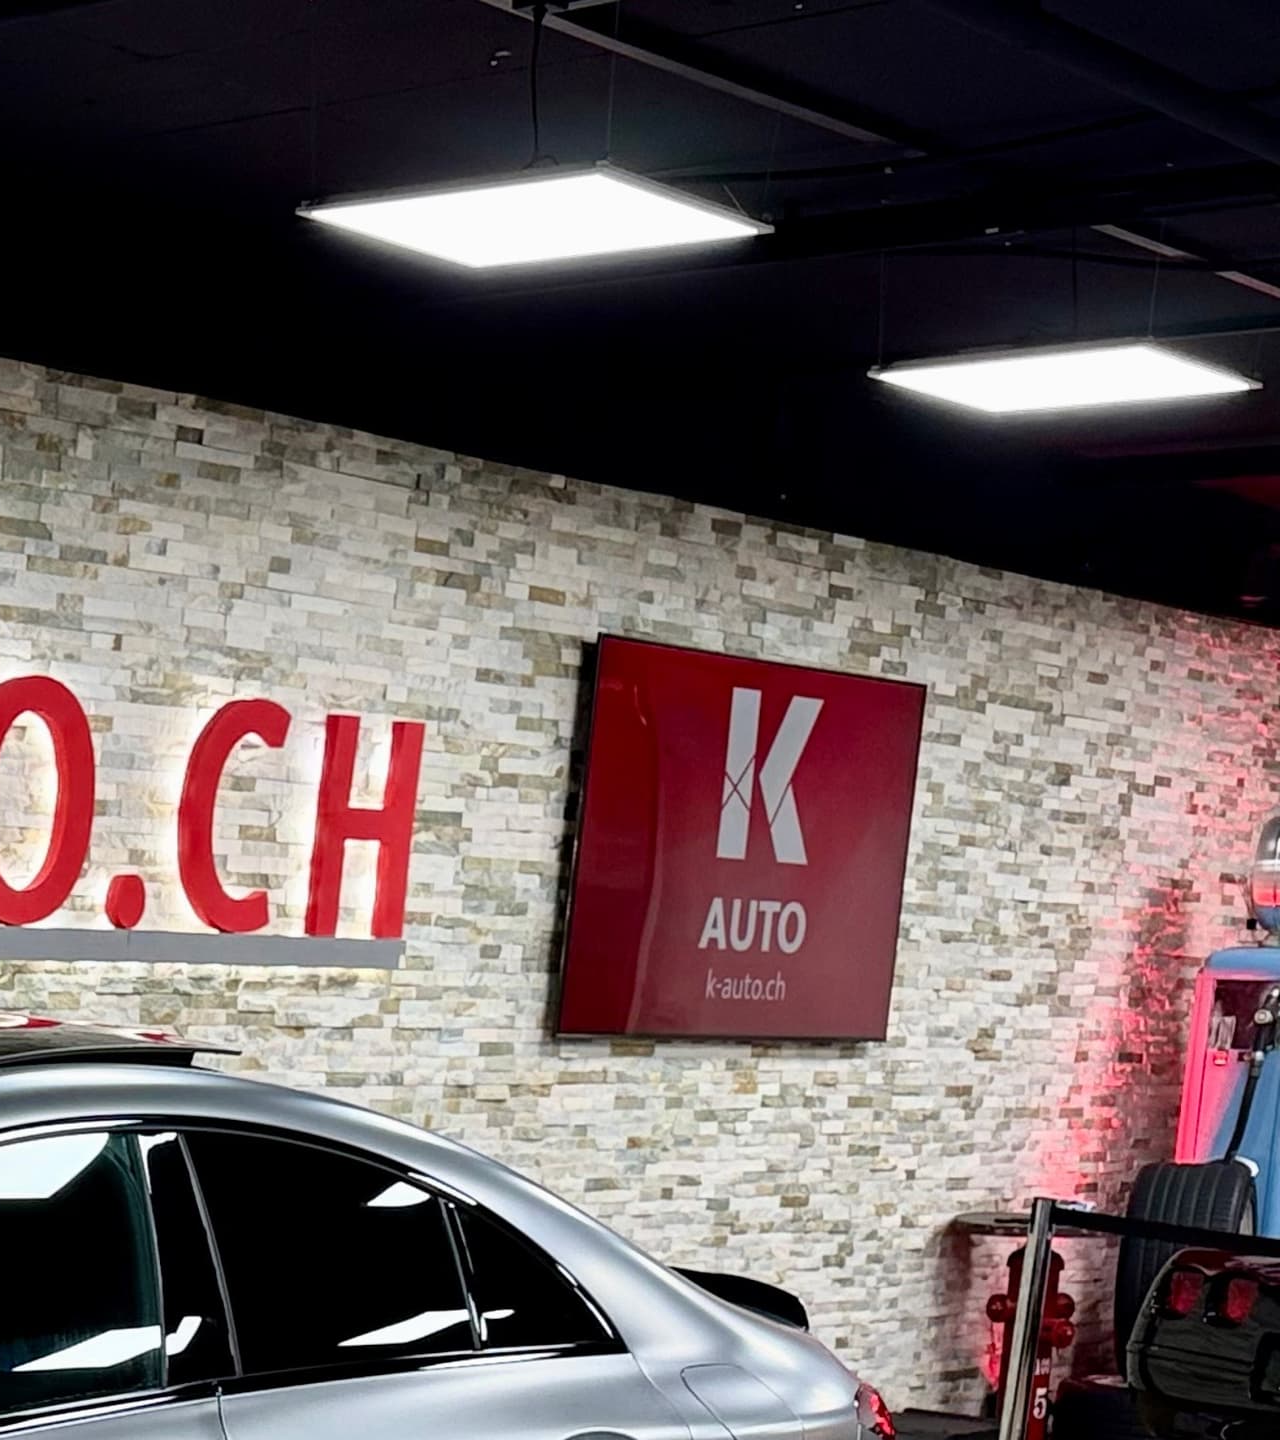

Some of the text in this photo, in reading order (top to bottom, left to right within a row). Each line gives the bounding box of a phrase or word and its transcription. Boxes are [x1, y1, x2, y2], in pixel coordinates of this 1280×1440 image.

[715, 686, 825, 866] K
[698, 896, 807, 955] AUTO
[704, 968, 787, 1002] k-auto.ch
